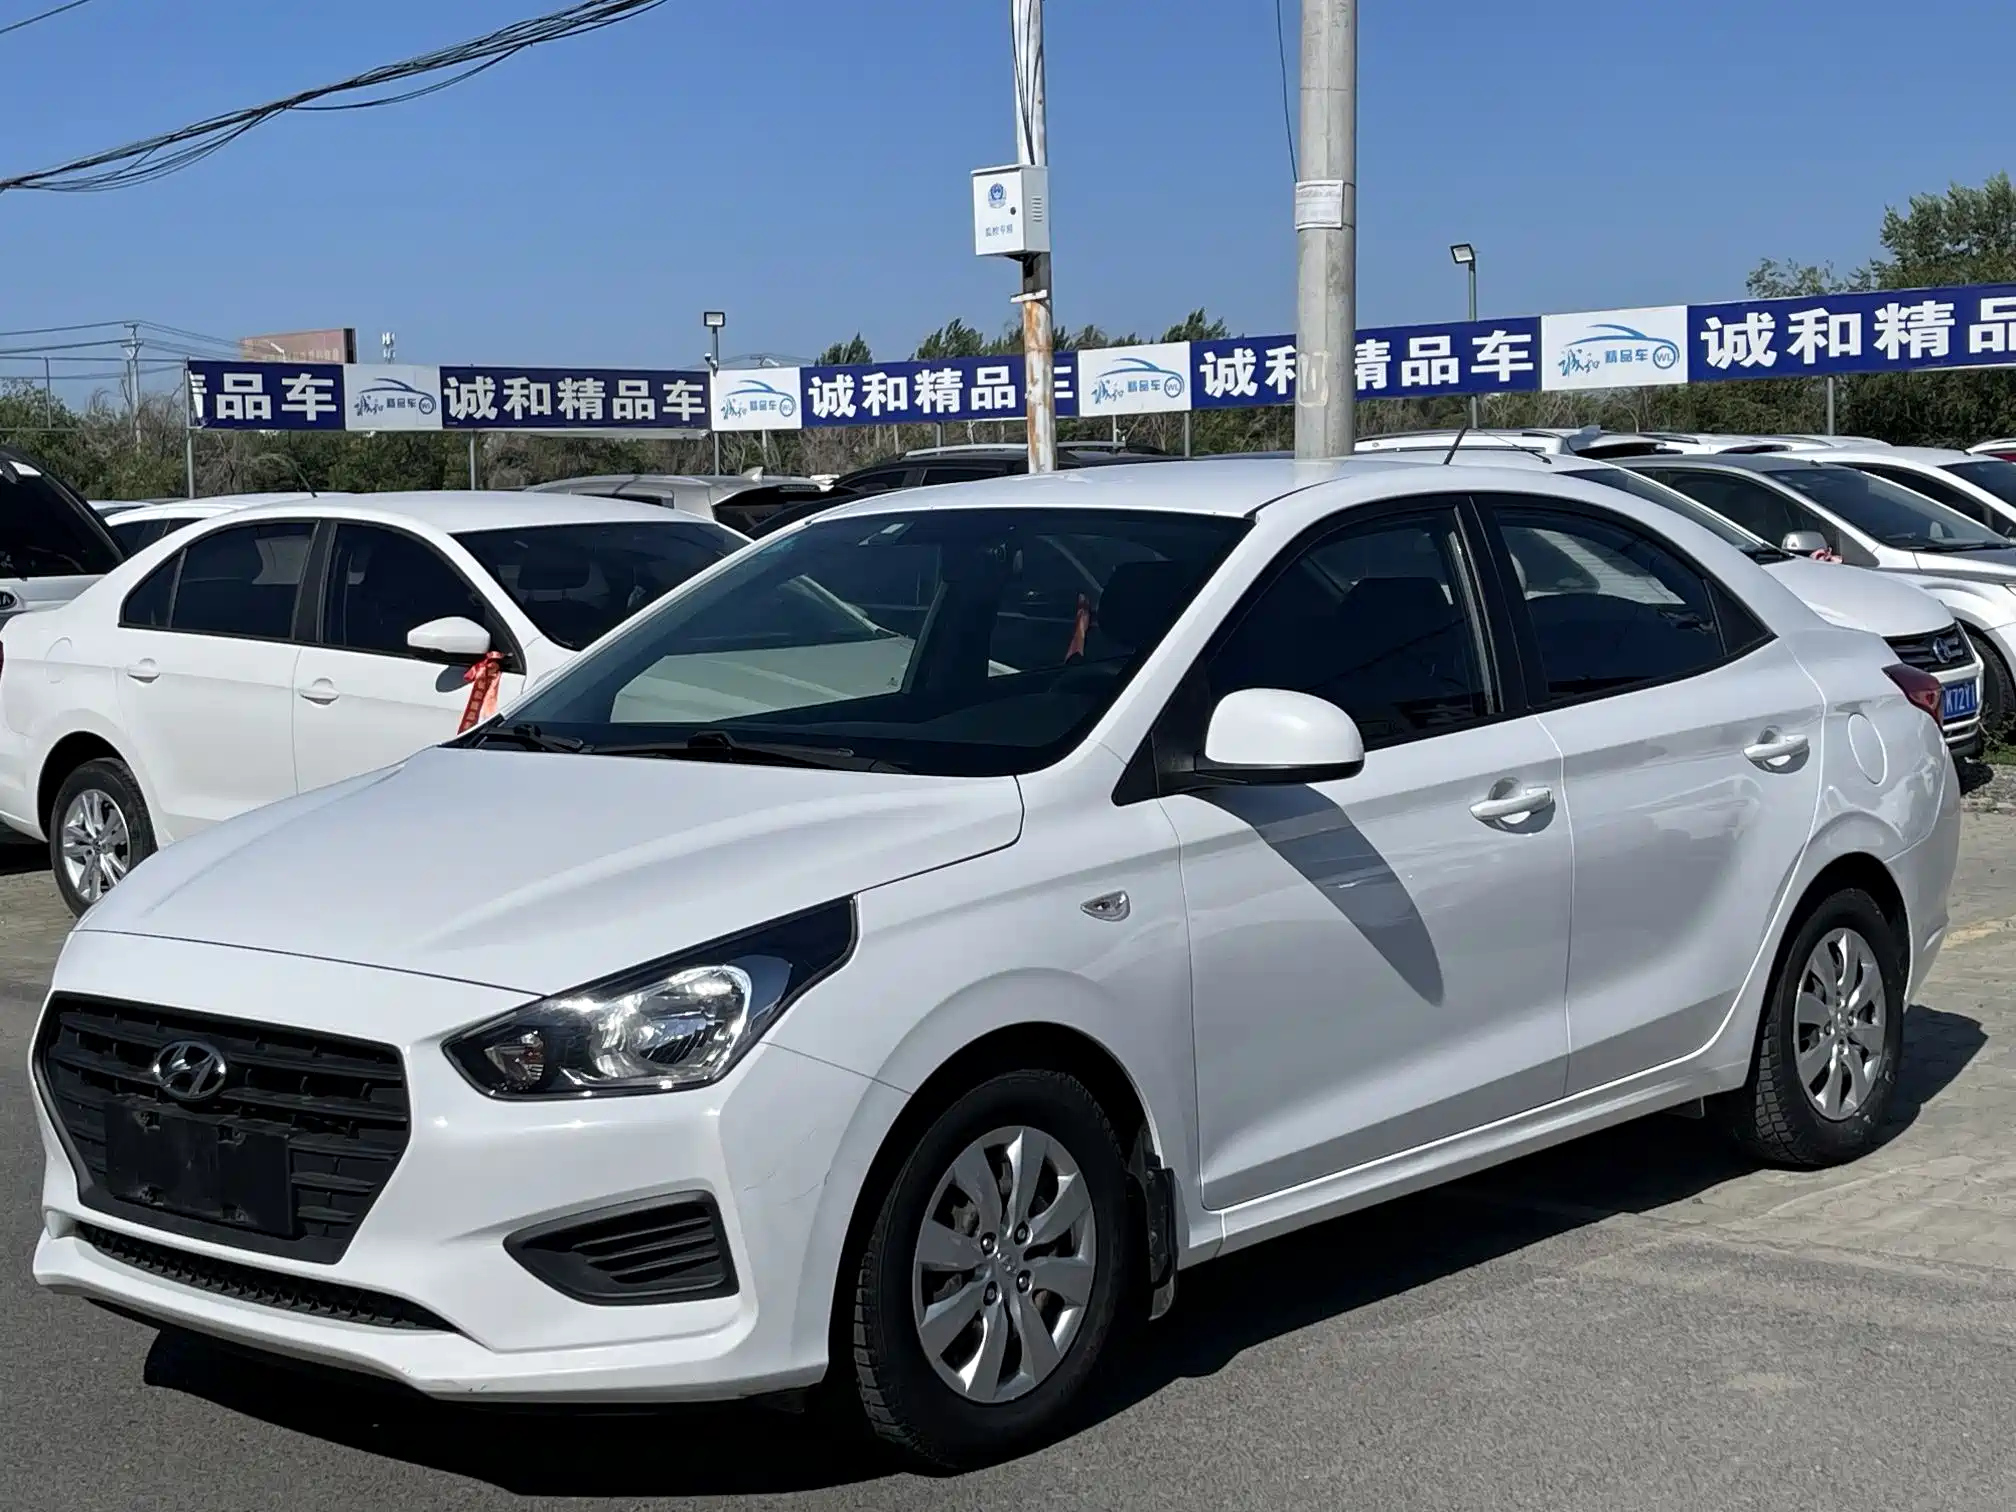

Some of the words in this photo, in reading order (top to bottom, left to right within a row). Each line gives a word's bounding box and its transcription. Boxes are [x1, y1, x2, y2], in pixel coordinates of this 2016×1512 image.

[1604, 348, 1649, 364] 精品车
[443, 375, 707, 421] 诚和精品车
